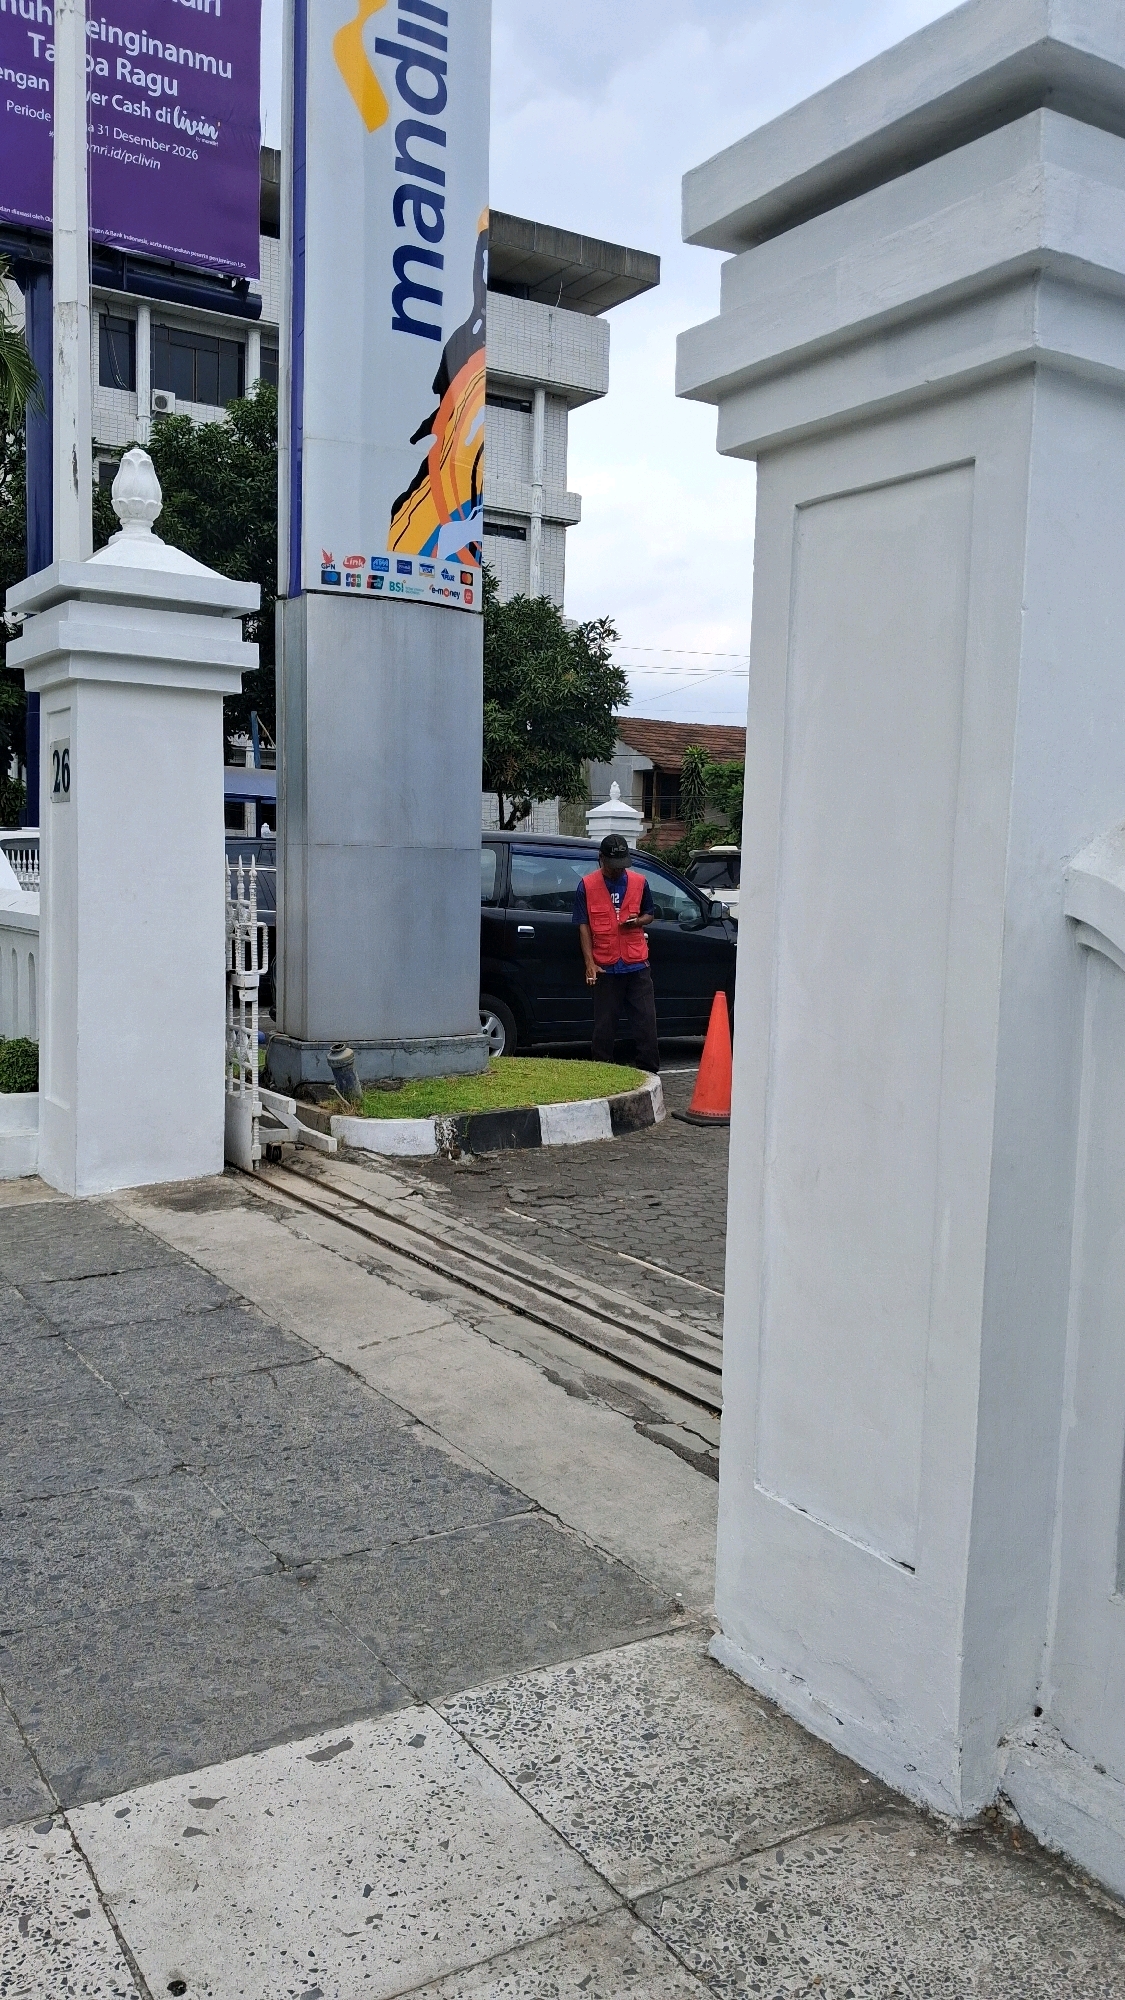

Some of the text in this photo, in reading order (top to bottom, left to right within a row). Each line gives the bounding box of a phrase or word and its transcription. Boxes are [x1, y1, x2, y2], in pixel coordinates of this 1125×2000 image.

[85, 17, 232, 79] einginanmu
[116, 57, 178, 97] Ragu
[112, 94, 151, 119] Cash
[155, 106, 171, 125] di
[6, 99, 52, 122] Periode
[97, 123, 110, 137] 31
[113, 127, 171, 152] Desember
[171, 143, 199, 161] 2026
[86, 142, 161, 170] mri.id/pclivin
[343, 556, 366, 569] Link
[388, 581, 404, 593] BSI
[431, 587, 461, 600] e-money
[52, 748, 71, 793] 26
